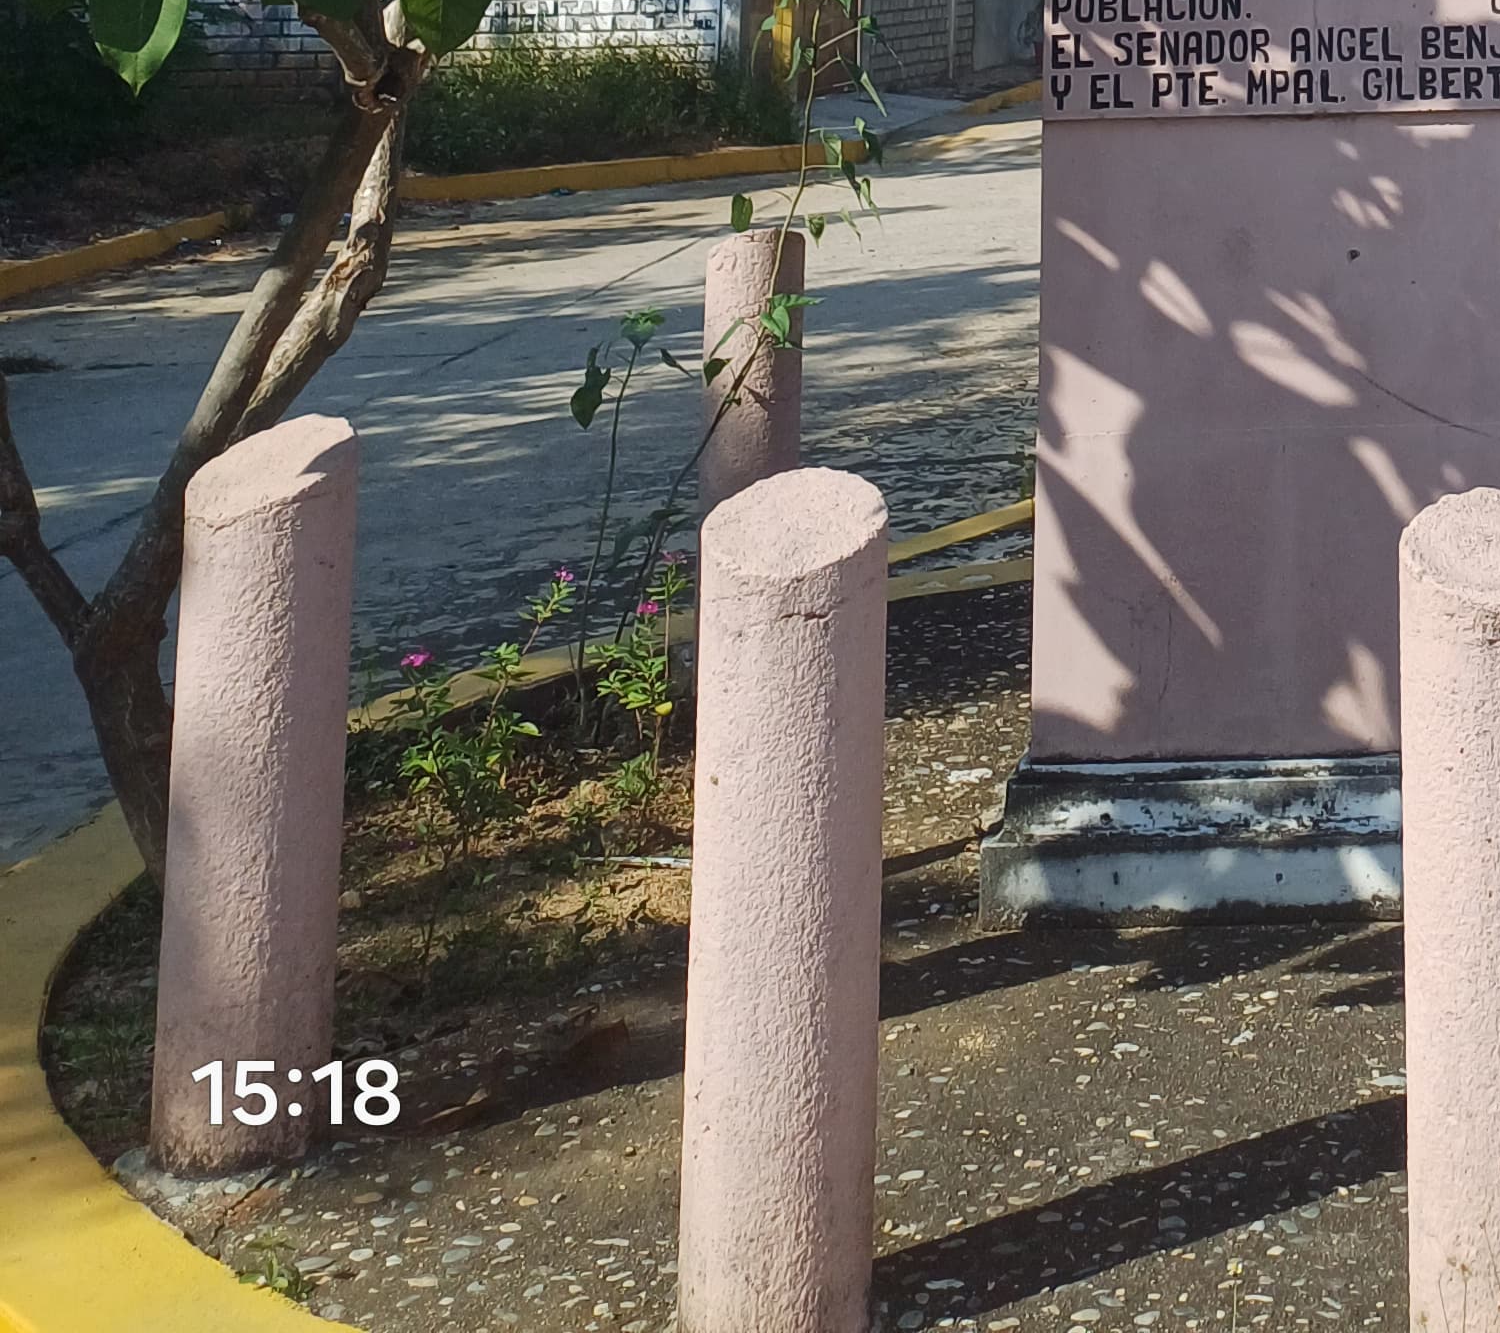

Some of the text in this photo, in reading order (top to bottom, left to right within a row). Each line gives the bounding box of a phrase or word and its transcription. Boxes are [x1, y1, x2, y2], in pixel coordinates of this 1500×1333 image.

[1050, 33, 1094, 70] EL
[1113, 27, 1271, 67] SENADOR
[1290, 25, 1403, 63] ANGEL
[1050, 73, 1073, 111] Y
[1089, 73, 1134, 110] EL
[1151, 71, 1227, 109] PTE.
[1245, 68, 1346, 106] MPAL.
